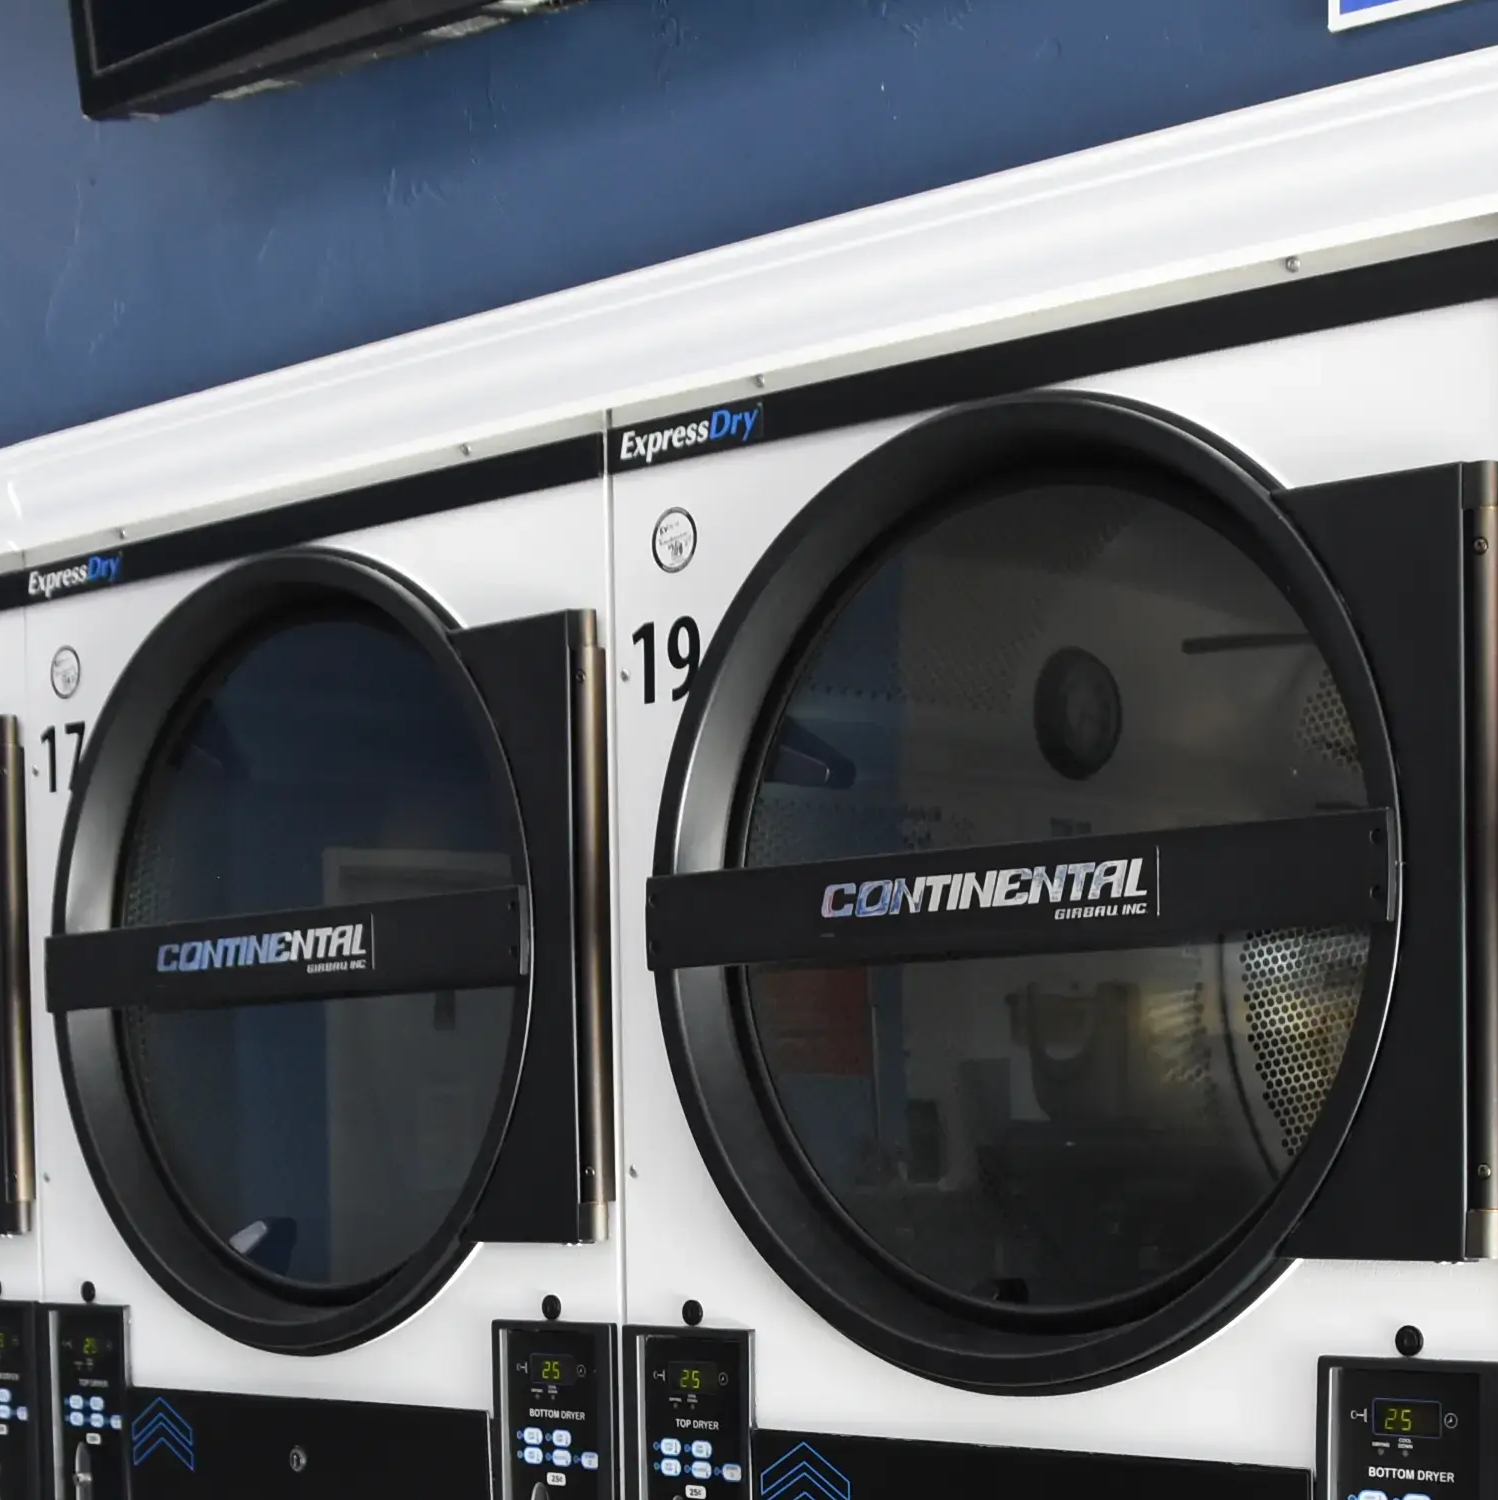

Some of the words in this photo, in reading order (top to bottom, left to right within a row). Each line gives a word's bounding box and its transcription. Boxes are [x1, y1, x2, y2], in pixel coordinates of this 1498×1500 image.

[619, 408, 758, 463] ExpressDry
[28, 556, 120, 598] ExpressDry
[632, 615, 701, 704] 19
[41, 721, 86, 793] 17
[821, 857, 1148, 918] CONTINENTAL
[157, 924, 366, 972] CONTINENTAL
[542, 1361, 561, 1380] 25
[679, 1369, 701, 1389] 25
[529, 1408, 560, 1419] BOTTOM
[561, 1409, 586, 1421] DRYER
[675, 1418, 692, 1429] TOP
[693, 1419, 719, 1431] DRYER
[1384, 1408, 1412, 1431] 25
[1368, 1466, 1415, 1480] BOTTOM
[1417, 1469, 1455, 1483] DRYER
